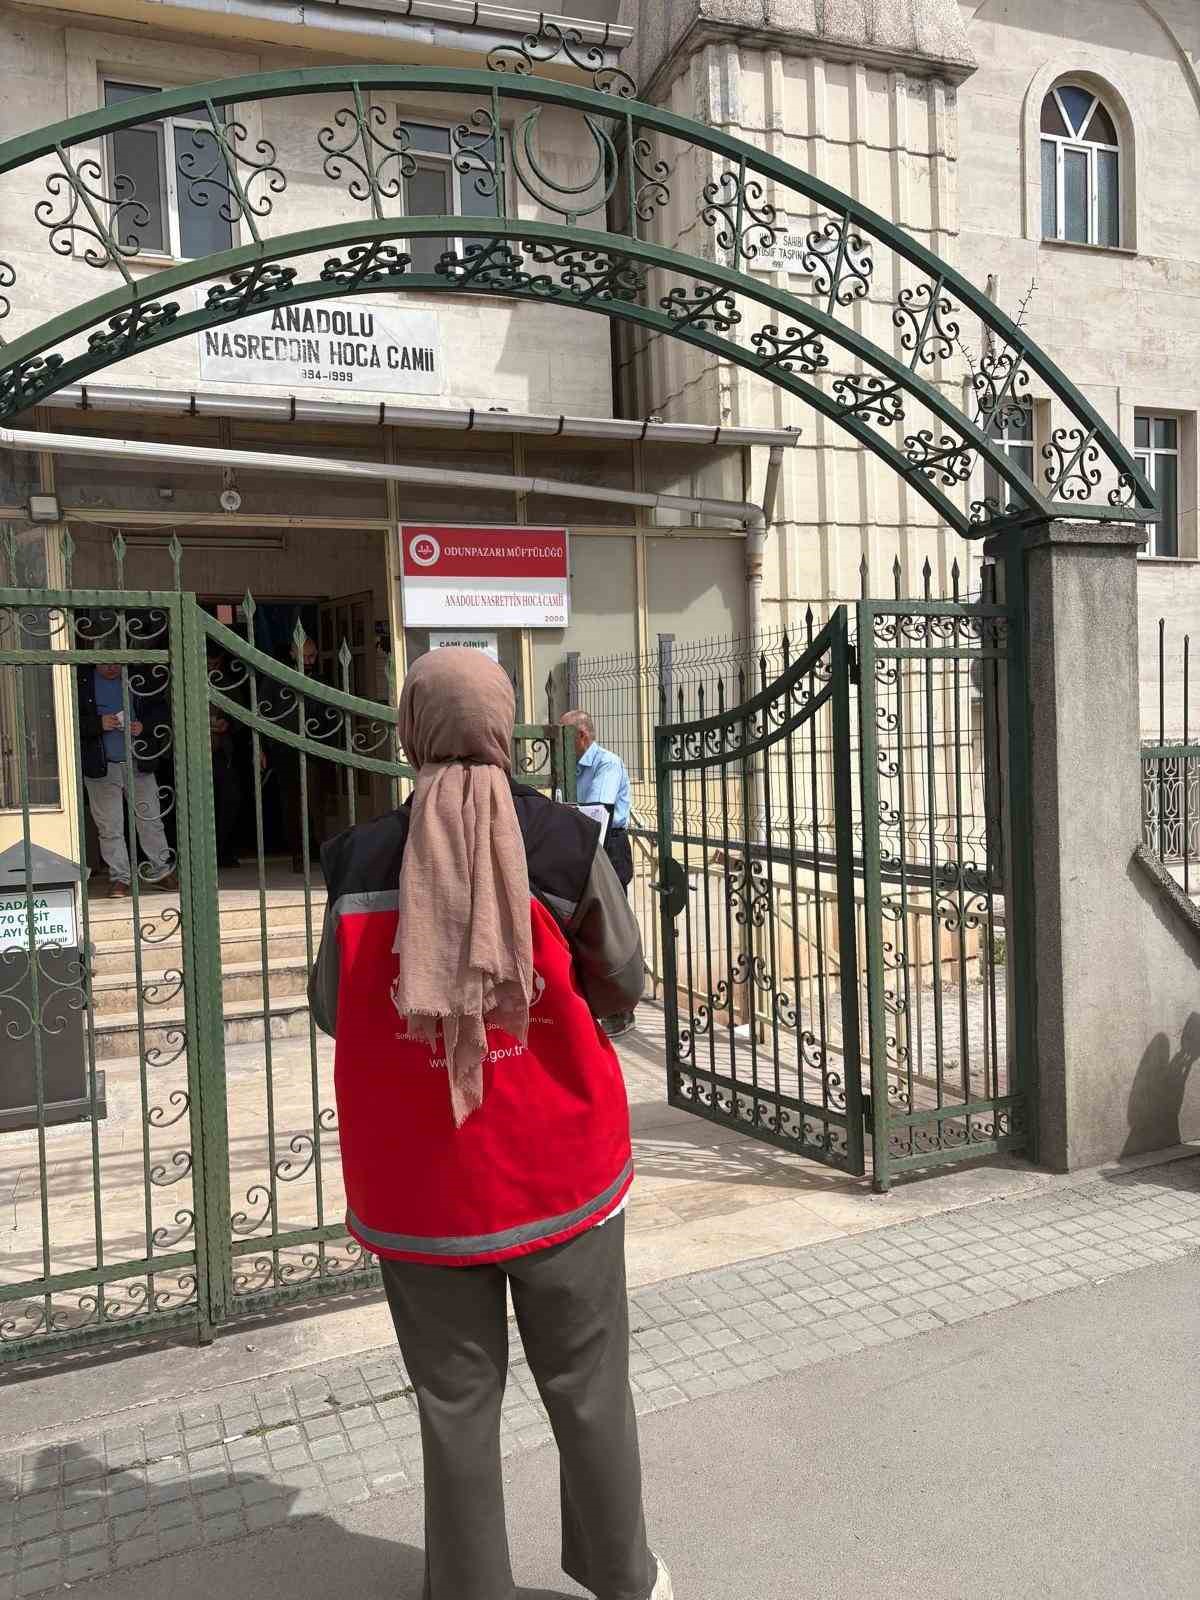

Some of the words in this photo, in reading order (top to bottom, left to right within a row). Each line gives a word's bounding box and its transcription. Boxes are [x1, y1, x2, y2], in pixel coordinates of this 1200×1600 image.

[270, 306, 374, 338] ANADOLU
[329, 341, 381, 369] HOCA
[444, 546, 505, 557] ODUNPAZARI
[506, 546, 563, 558] MÜFTÜLÜĞÜ
[446, 594, 480, 607] ANADOLU
[522, 594, 542, 607] HOCA
[17, 911, 50, 926] ÇŞİT
